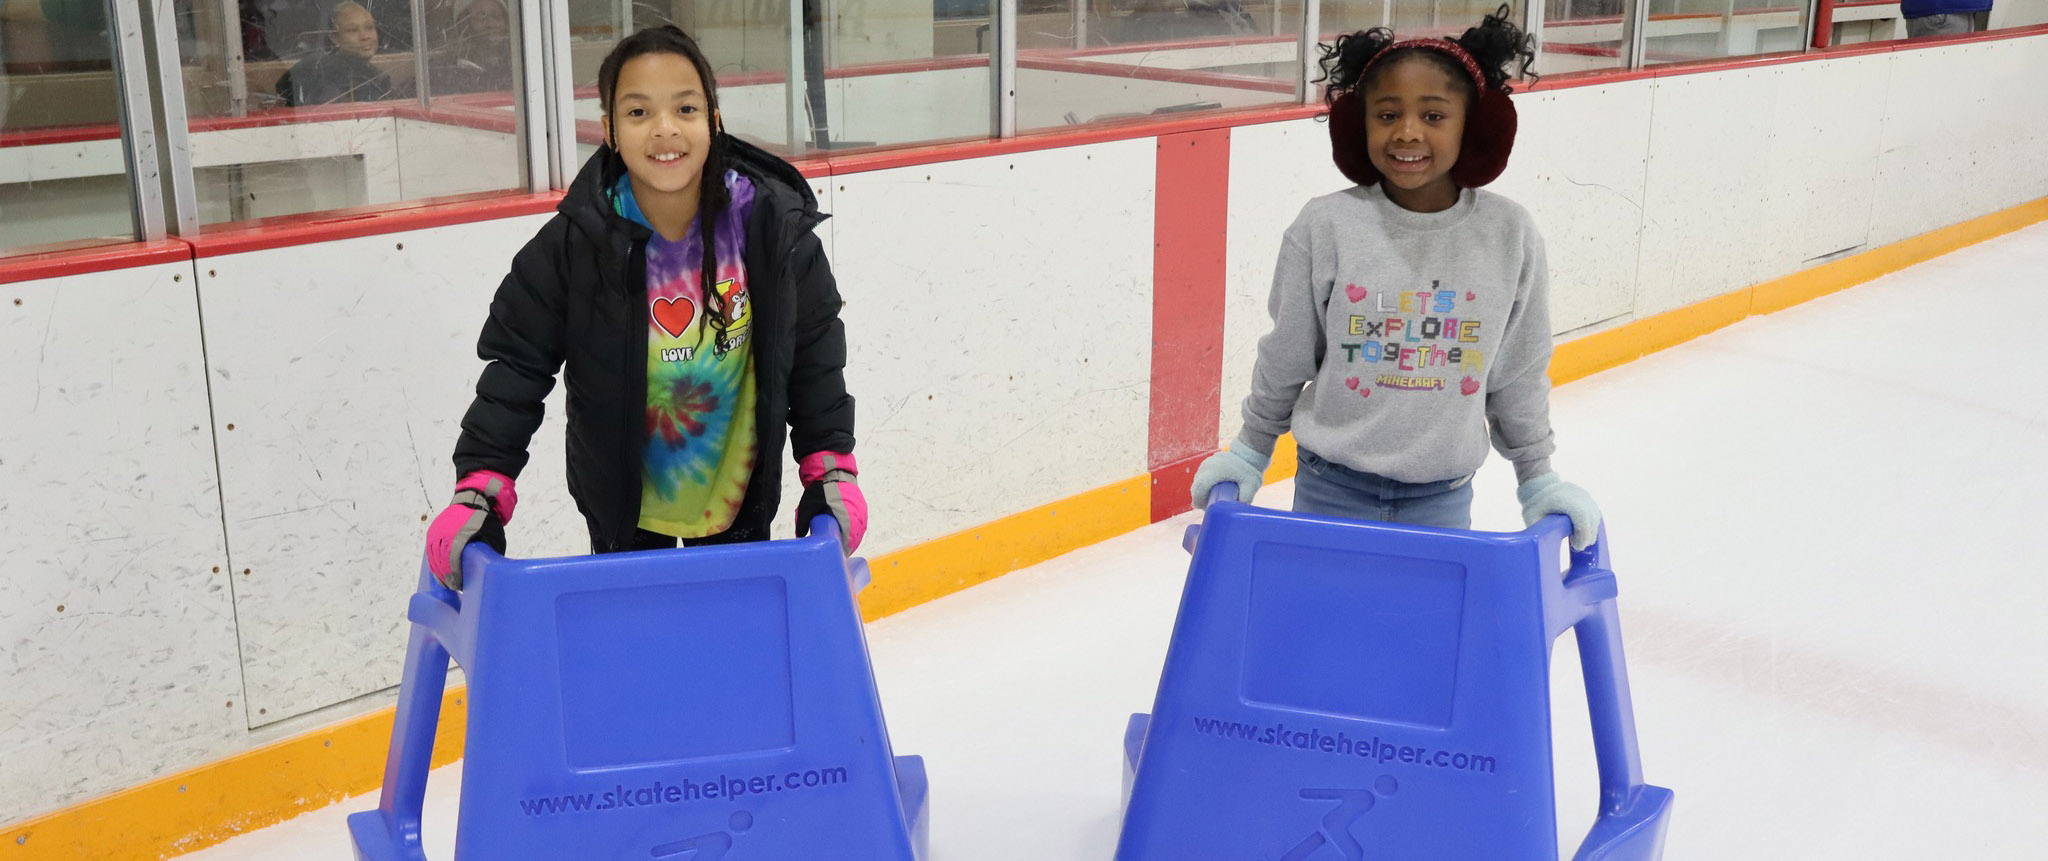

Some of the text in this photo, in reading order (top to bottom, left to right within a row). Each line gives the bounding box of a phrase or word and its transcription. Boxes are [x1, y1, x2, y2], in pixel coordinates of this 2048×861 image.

[1376, 280, 1456, 314] LET'S
[661, 347, 694, 362] LOVE
[1375, 374, 1447, 391] MINECRAFT
[1194, 716, 1497, 773] www.skatehelper.com
[519, 766, 848, 816] www.skatehelper.com
